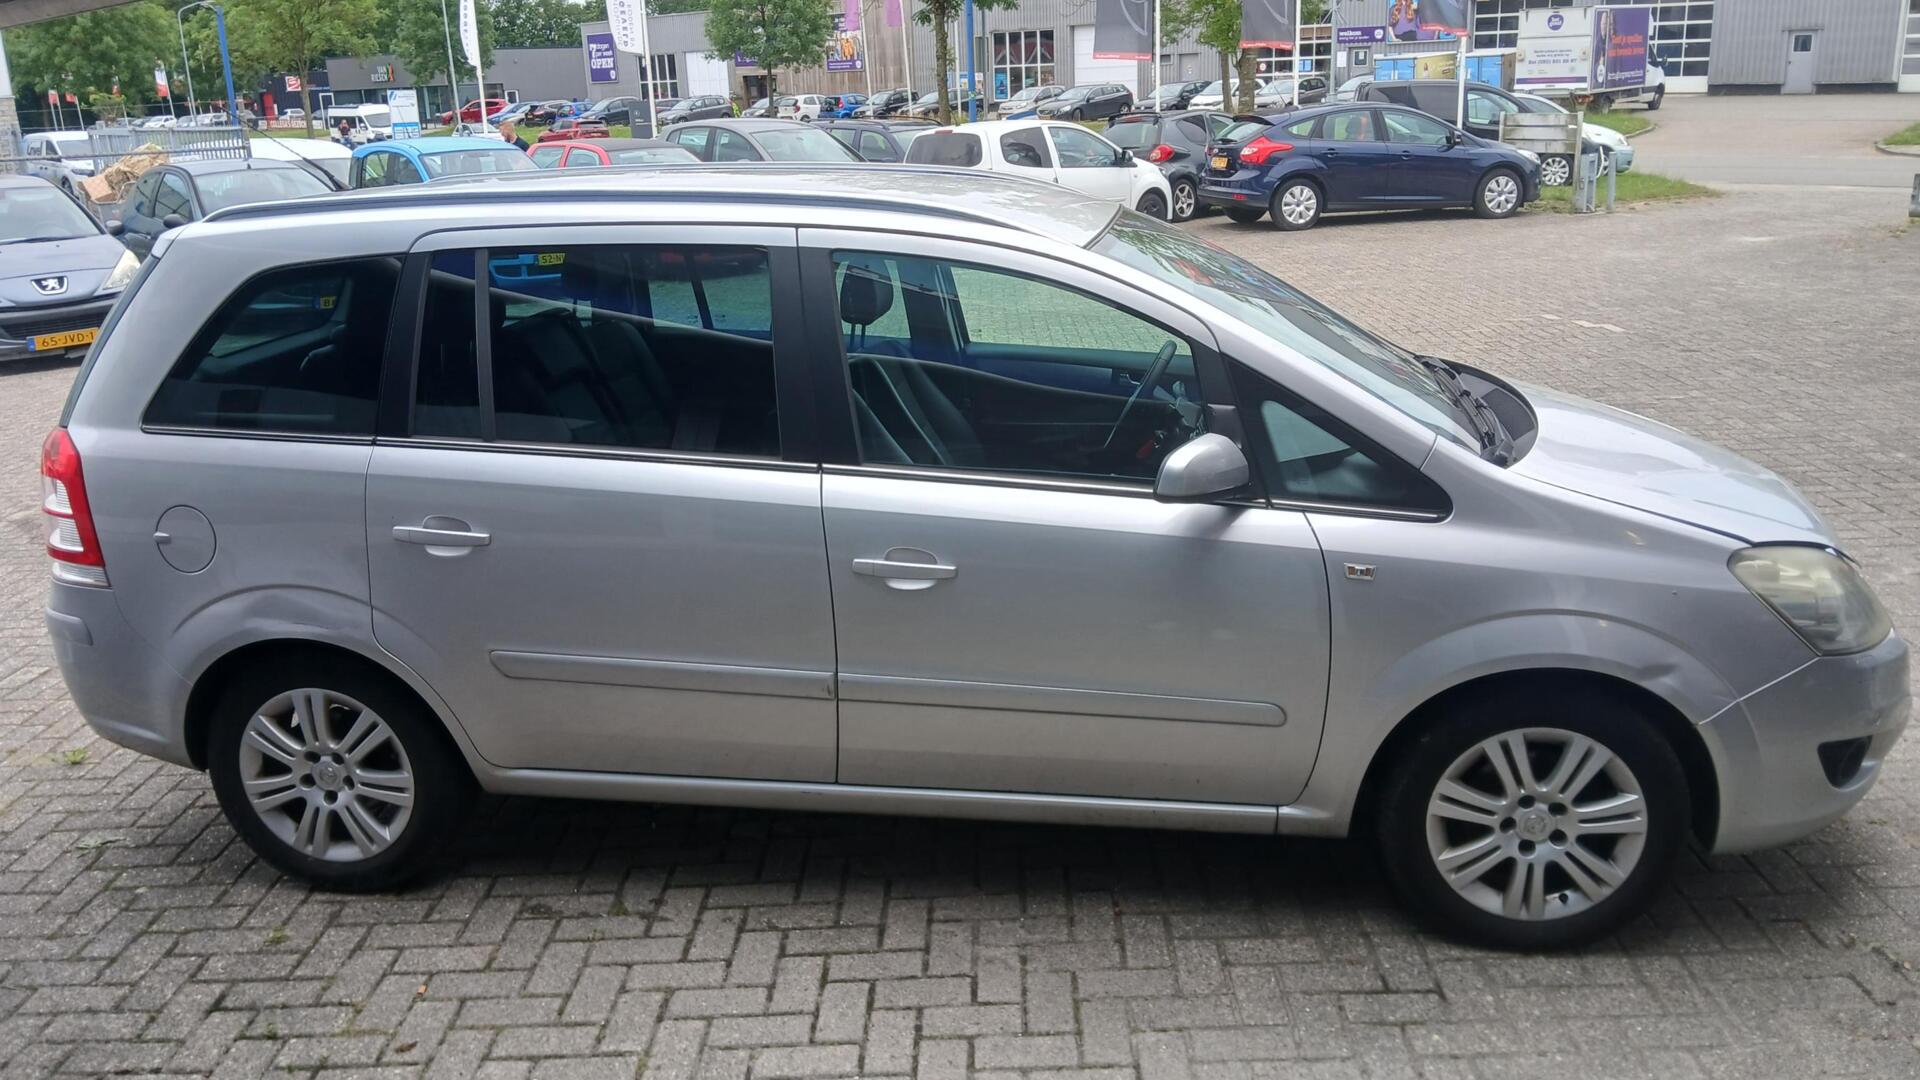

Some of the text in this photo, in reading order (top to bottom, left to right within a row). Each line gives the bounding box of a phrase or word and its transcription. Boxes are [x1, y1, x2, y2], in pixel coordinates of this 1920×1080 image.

[589, 43, 597, 59] 7
[591, 58, 614, 69] OPEN
[41, 331, 95, 348] 65-JVD-1
